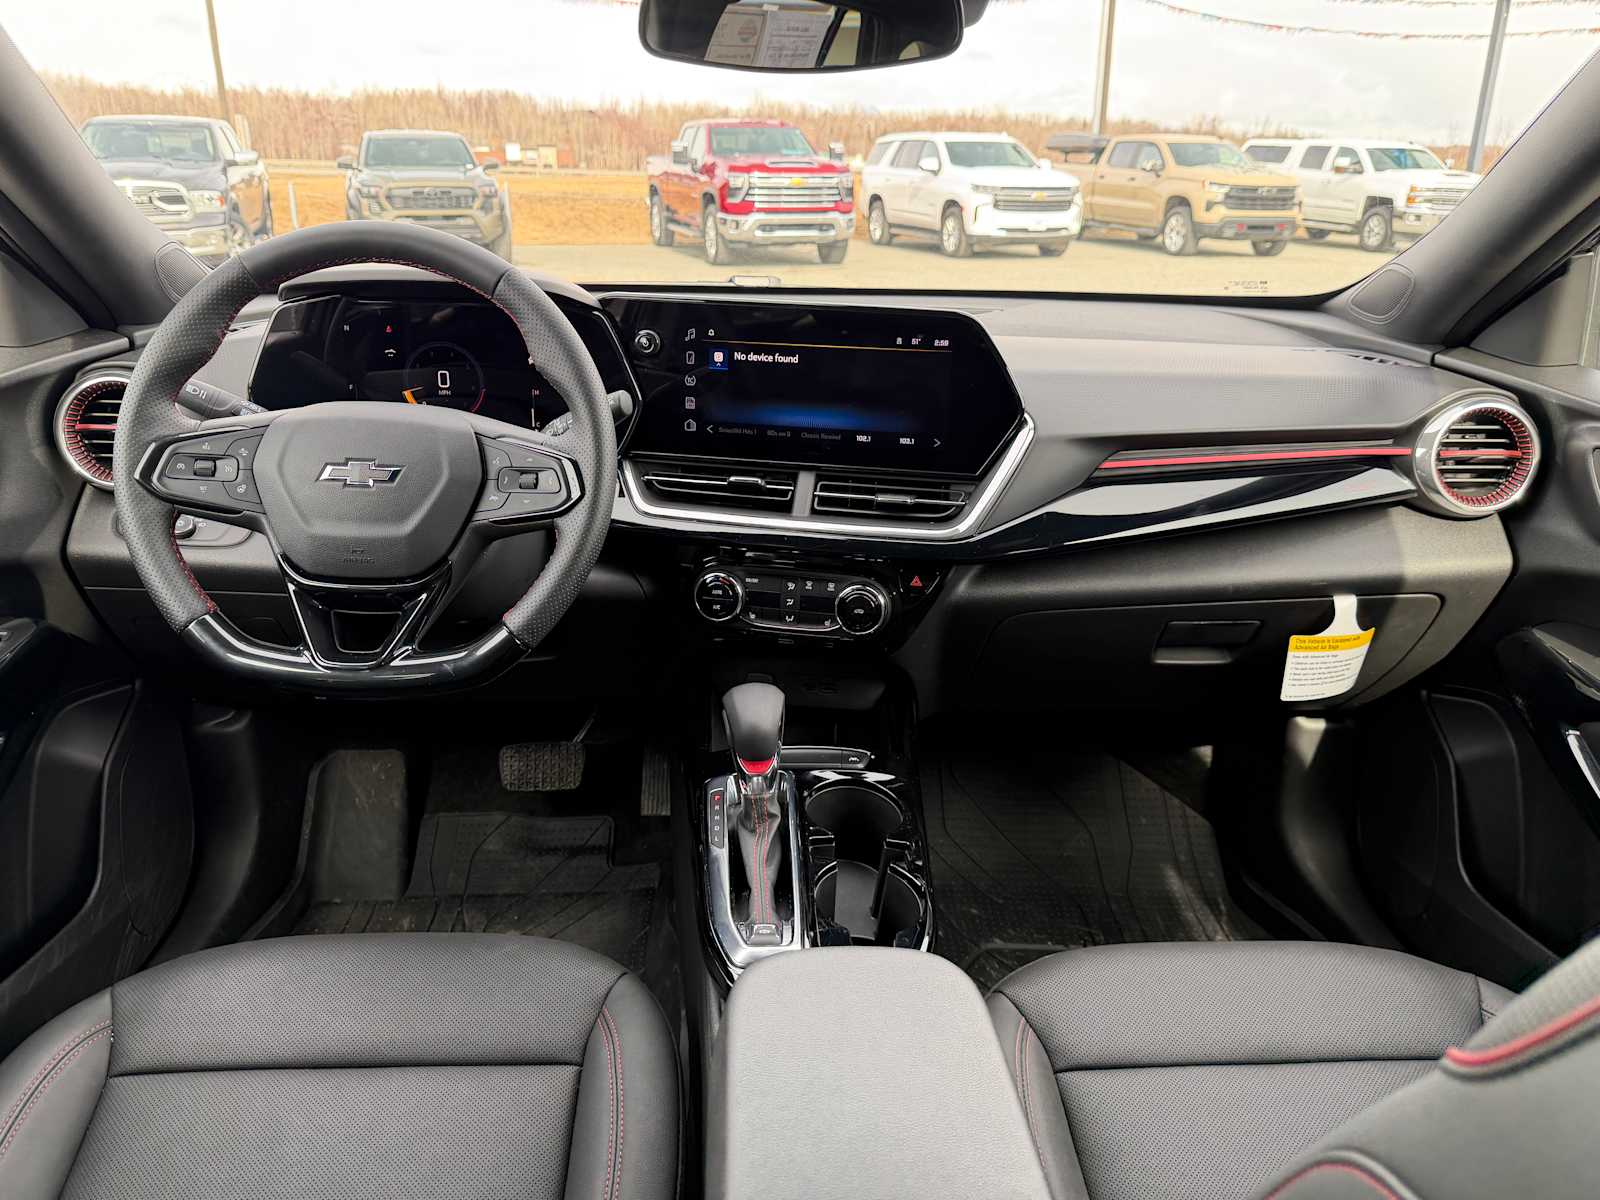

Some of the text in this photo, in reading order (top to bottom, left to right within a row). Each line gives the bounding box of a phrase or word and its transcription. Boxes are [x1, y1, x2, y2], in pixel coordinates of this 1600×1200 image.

[734, 351, 799, 363] No device found
[437, 370, 450, 388] 0
[856, 435, 872, 443] 102.1
